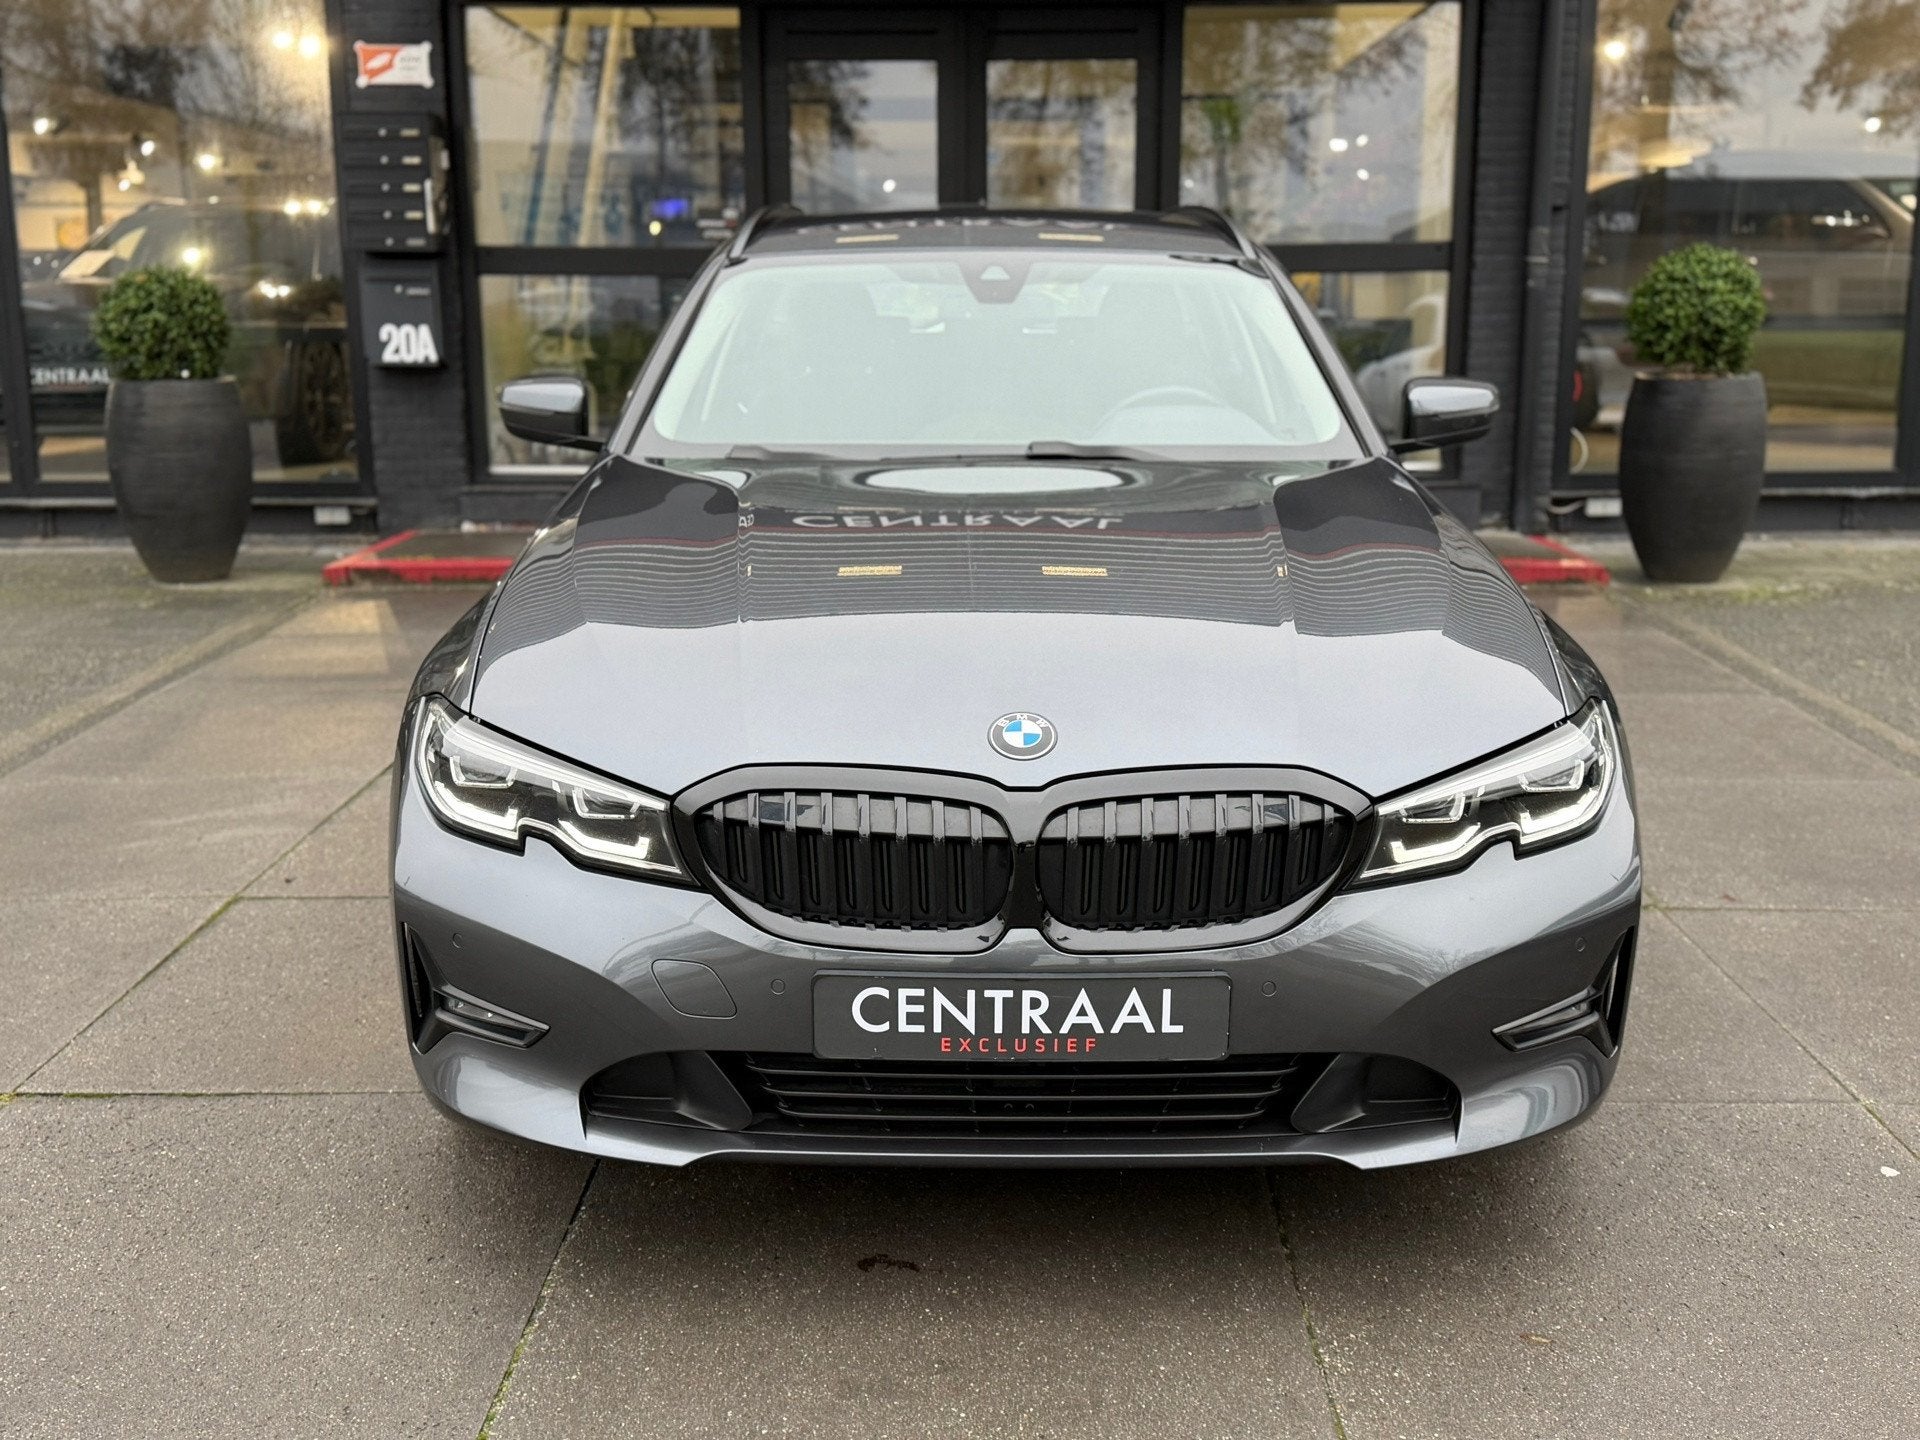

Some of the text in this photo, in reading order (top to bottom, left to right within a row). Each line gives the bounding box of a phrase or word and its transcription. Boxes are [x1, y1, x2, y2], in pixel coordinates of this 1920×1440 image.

[378, 323, 439, 363] 20A
[851, 986, 1184, 1035] CENTRAAL
[941, 1037, 1097, 1052] EXCLUSIEF
